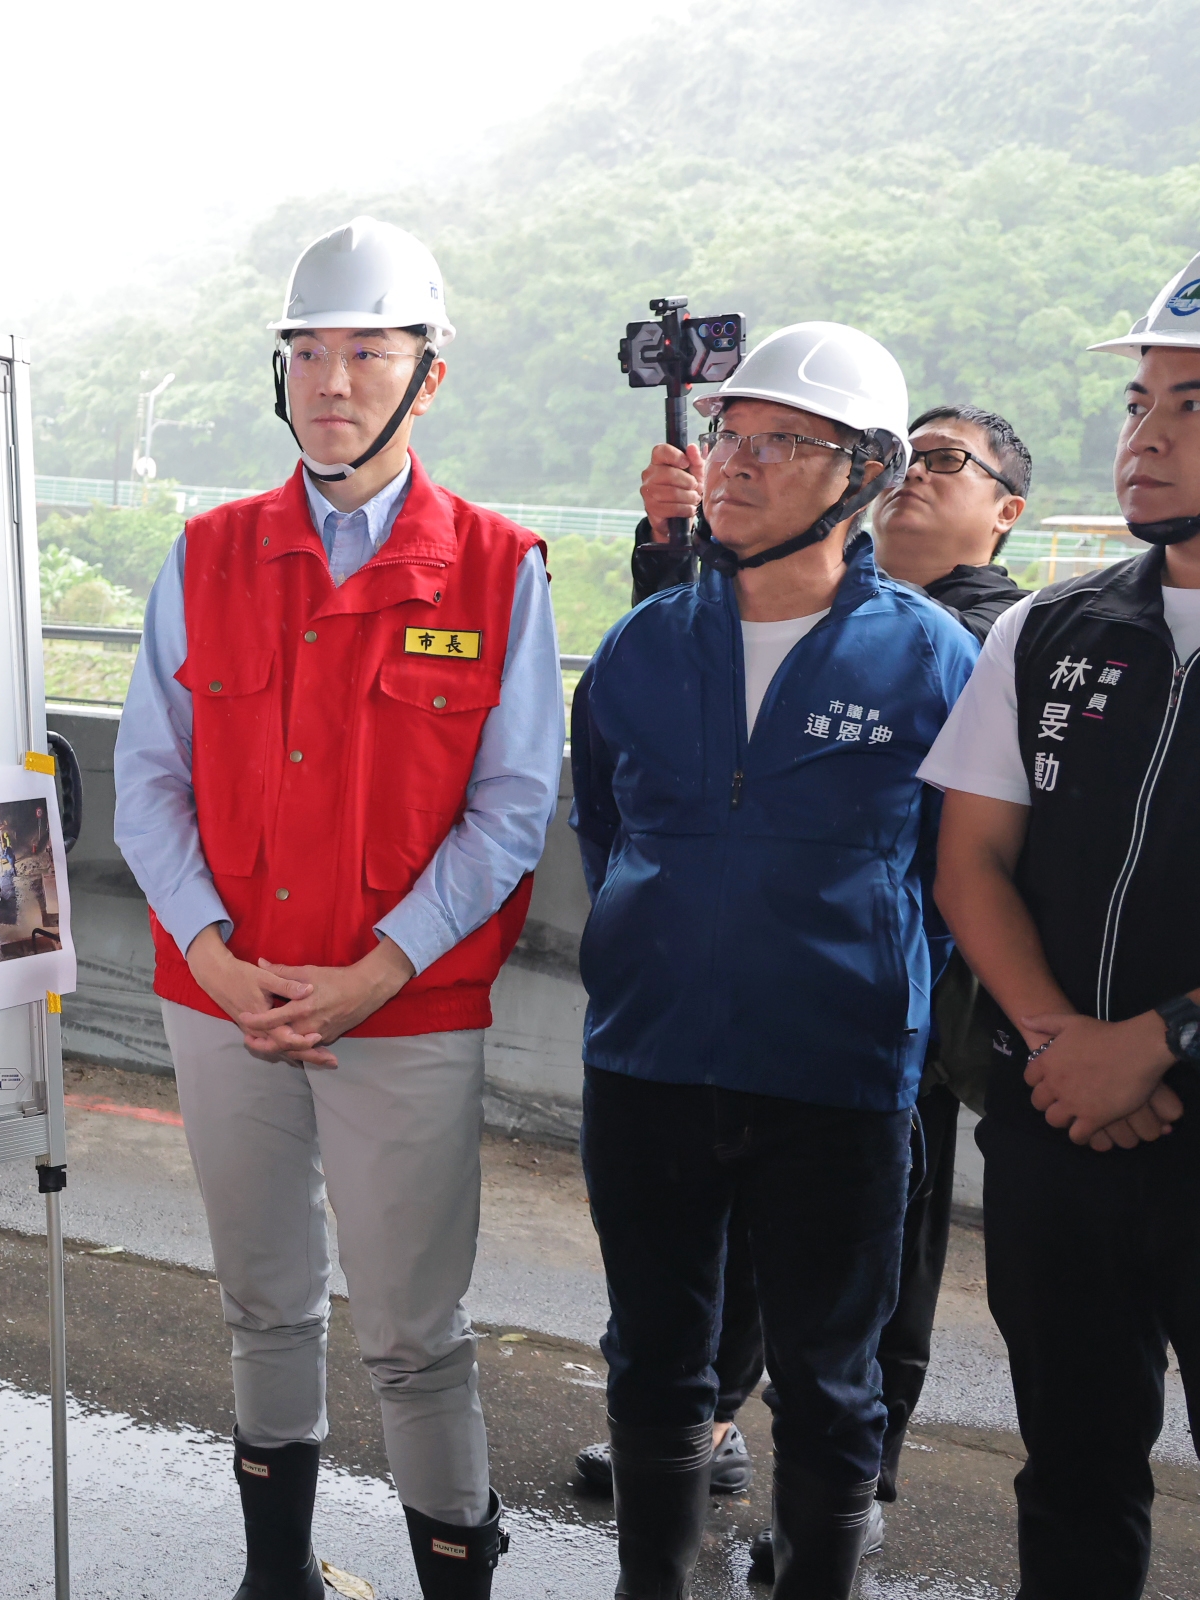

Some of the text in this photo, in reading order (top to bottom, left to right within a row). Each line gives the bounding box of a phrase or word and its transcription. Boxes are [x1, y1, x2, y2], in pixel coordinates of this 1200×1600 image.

[418, 632, 463, 653] 市長
[1085, 667, 1122, 712] 議員
[828, 699, 881, 722] 市議員
[804, 712, 893, 745] 連恩典
[1034, 655, 1093, 792] 林旻動
[242, 1462, 267, 1474] HUNTER
[433, 1543, 465, 1554] HUNTER
